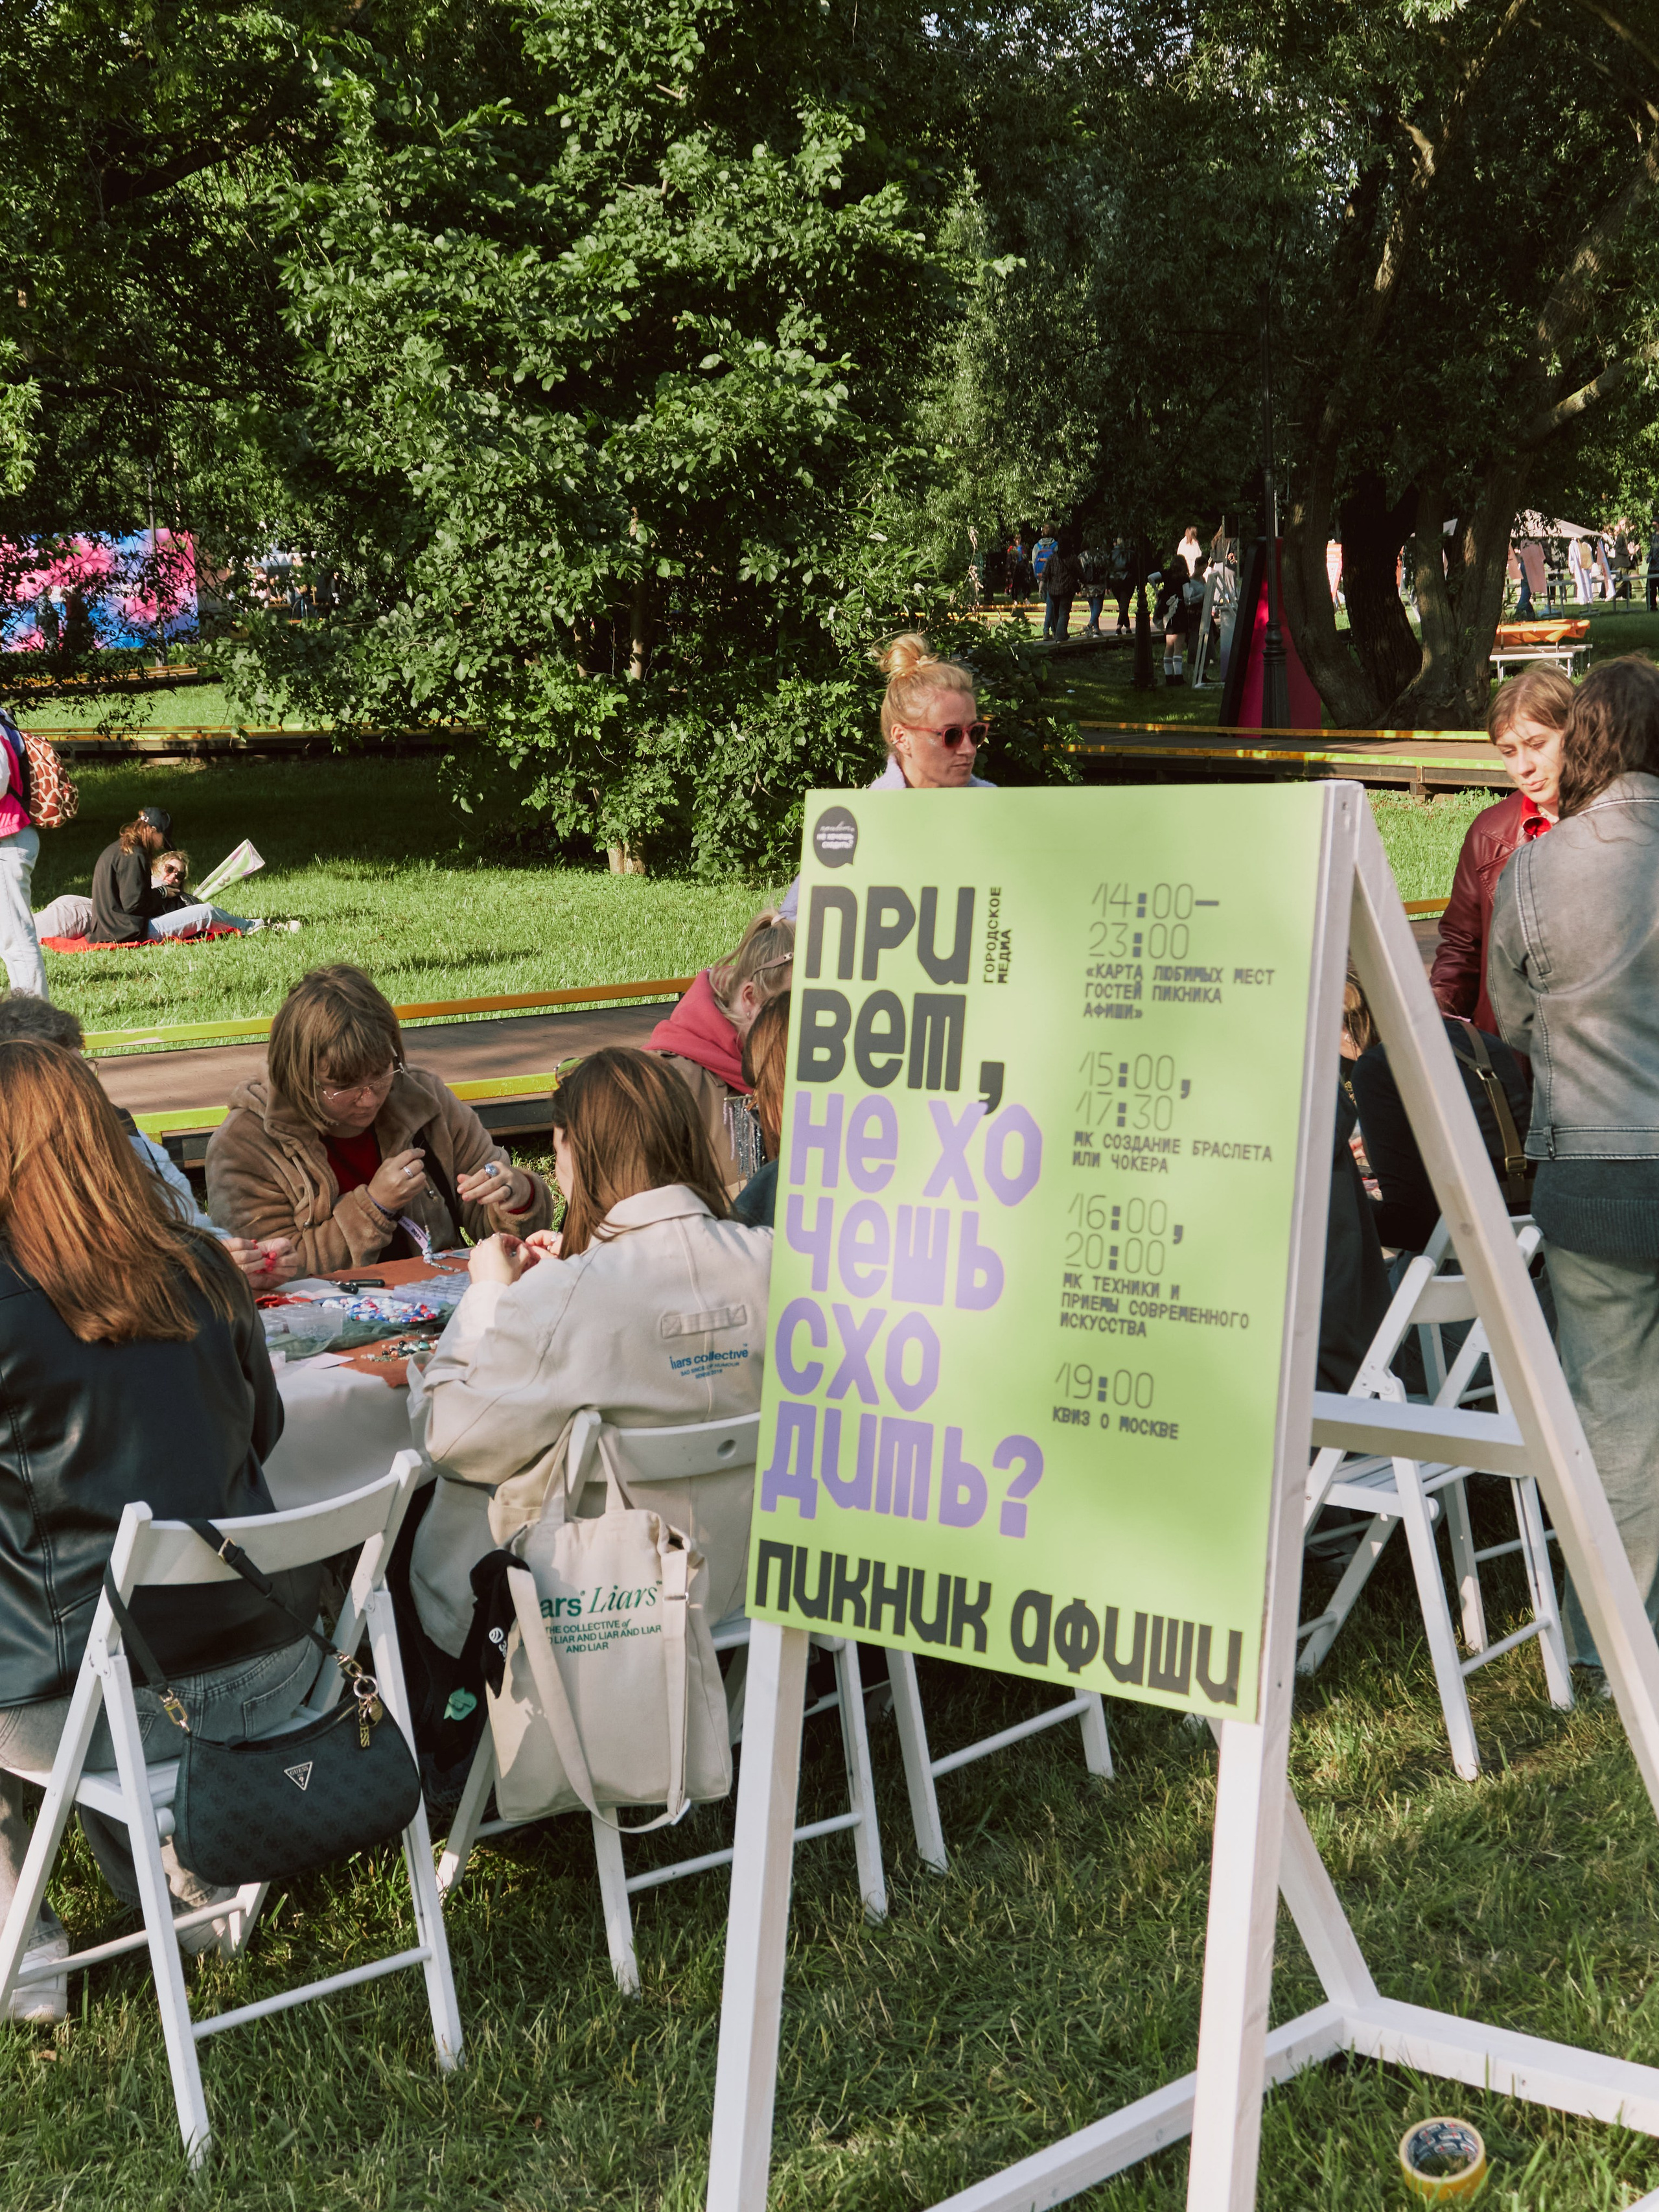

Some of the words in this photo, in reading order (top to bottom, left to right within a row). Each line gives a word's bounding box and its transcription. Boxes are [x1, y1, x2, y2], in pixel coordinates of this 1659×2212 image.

[984, 887, 1001, 983] ГОРОДСКОЕ
[1089, 921, 1189, 960] 23:00
[997, 929, 1012, 983] МЕДИА
[1085, 977, 1142, 1000] ГОСТЕЙ
[1152, 984, 1222, 1003] ПИКНИКА
[1086, 963, 1143, 981] «КАРТА
[1153, 965, 1224, 983] ЛЮБИМЫХ
[1233, 968, 1275, 985] МЕСТ
[1083, 1002, 1143, 1019] АФИШИ»
[1079, 1051, 1191, 1099] 15:00,
[1076, 1090, 1173, 1132] 17:30
[1073, 1150, 1101, 1168] ИЛИ
[1111, 1154, 1168, 1174] ЧОКЕРА
[1074, 1130, 1095, 1147] МК
[1103, 1133, 1181, 1154] СОЗДАНИЕ
[1192, 1139, 1273, 1162] БРАСЛЕТА
[1068, 1193, 1184, 1245] 16:00,
[1065, 1231, 1165, 1276] 20:00
[1062, 1272, 1083, 1290] МК
[1093, 1275, 1160, 1298] ТЕХНИКИ
[1170, 1284, 1180, 1301] И
[1060, 1312, 1147, 1337] ИСКУССТВА
[1062, 1292, 1119, 1314] ПРИЕМЫ
[1129, 1299, 1249, 1329] СОВРЕМЕННОГО
[1055, 1362, 1154, 1409] 19:00
[1052, 1406, 1091, 1426] КВИЗ
[1100, 1413, 1110, 1430] О
[1119, 1415, 1179, 1440] МОСКВЕ
[554, 1634, 575, 1645] LIAR
[577, 1632, 597, 1643] AND
[598, 1629, 619, 1640] LIAR
[620, 1627, 640, 1638] AND
[642, 1624, 662, 1635] LIAR
[563, 1620, 620, 1633] COLLECTIVE
[621, 1618, 631, 1629] of
[566, 1644, 586, 1653] AND
[587, 1642, 609, 1651] LIAR
[290, 1765, 309, 1776] GUESS
